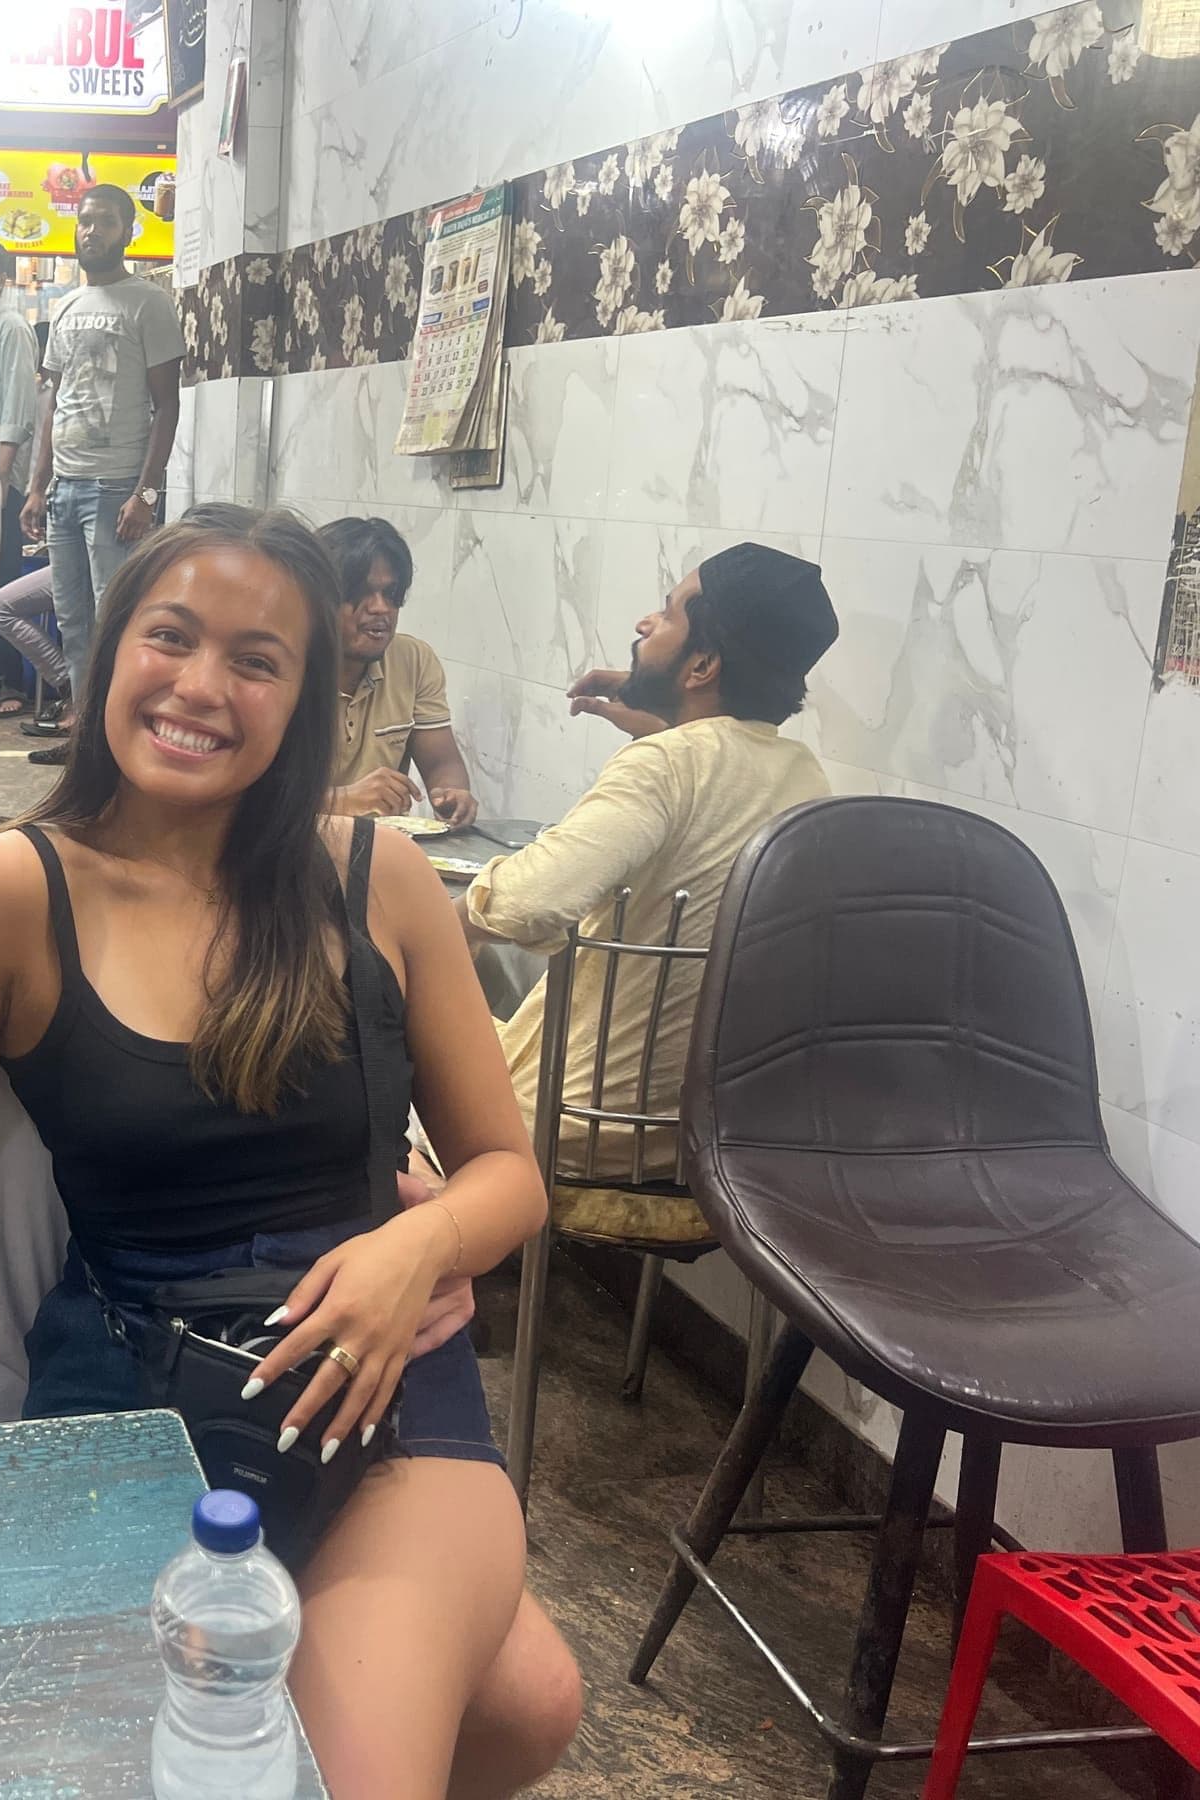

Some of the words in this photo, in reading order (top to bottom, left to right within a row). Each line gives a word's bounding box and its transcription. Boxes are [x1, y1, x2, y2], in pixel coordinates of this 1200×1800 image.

[10, 8, 145, 68] ABUL
[69, 67, 145, 97] SWEETS
[57, 315, 118, 332] LAYBOY
